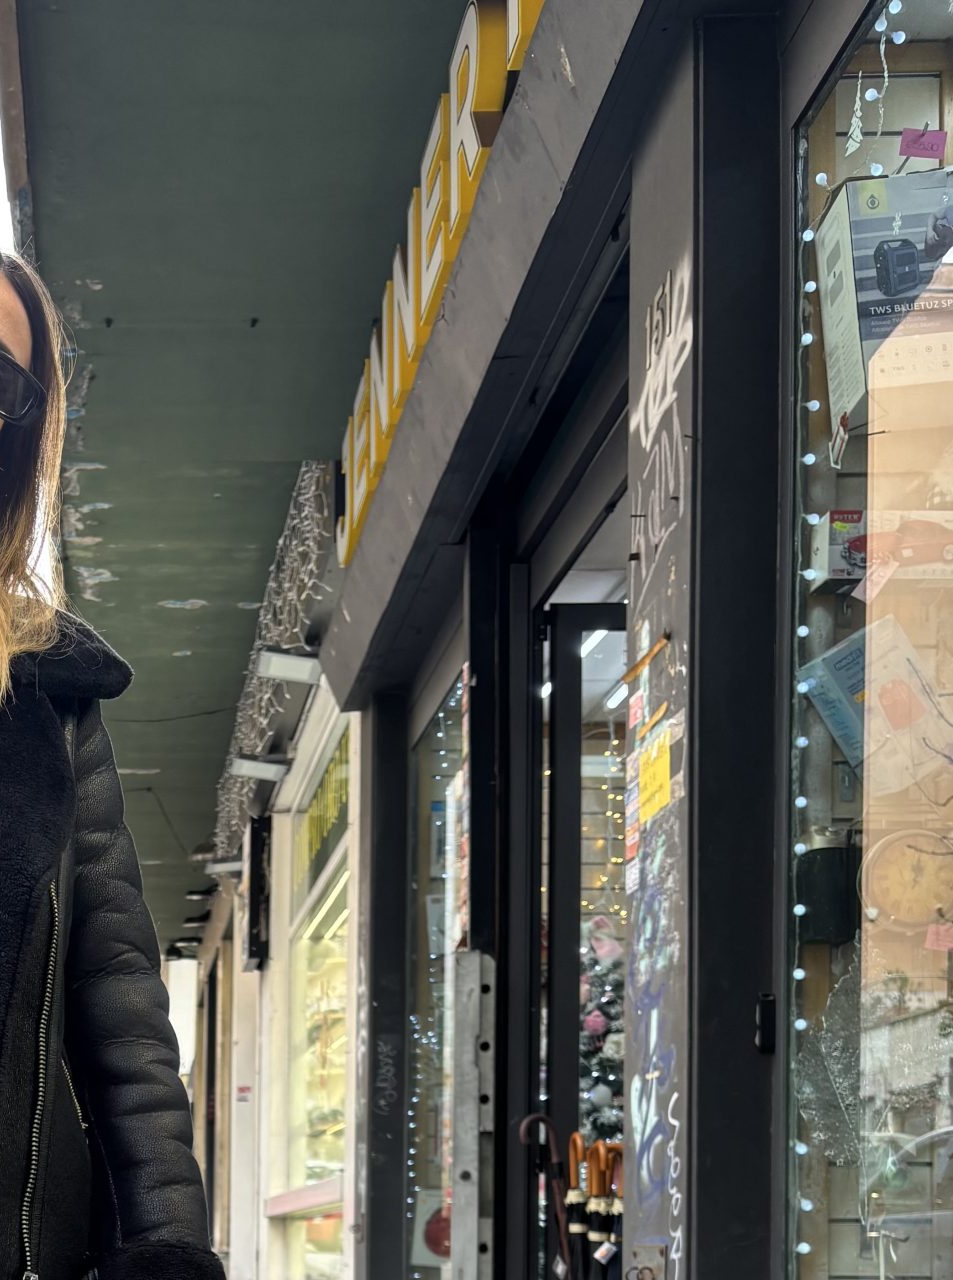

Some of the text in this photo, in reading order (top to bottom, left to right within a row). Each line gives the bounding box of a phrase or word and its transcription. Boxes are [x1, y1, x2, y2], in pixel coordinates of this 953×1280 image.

[336, 0, 486, 568] JENNER
[869, 305, 891, 315] TWS
[894, 301, 940, 312] BLUETUZ
